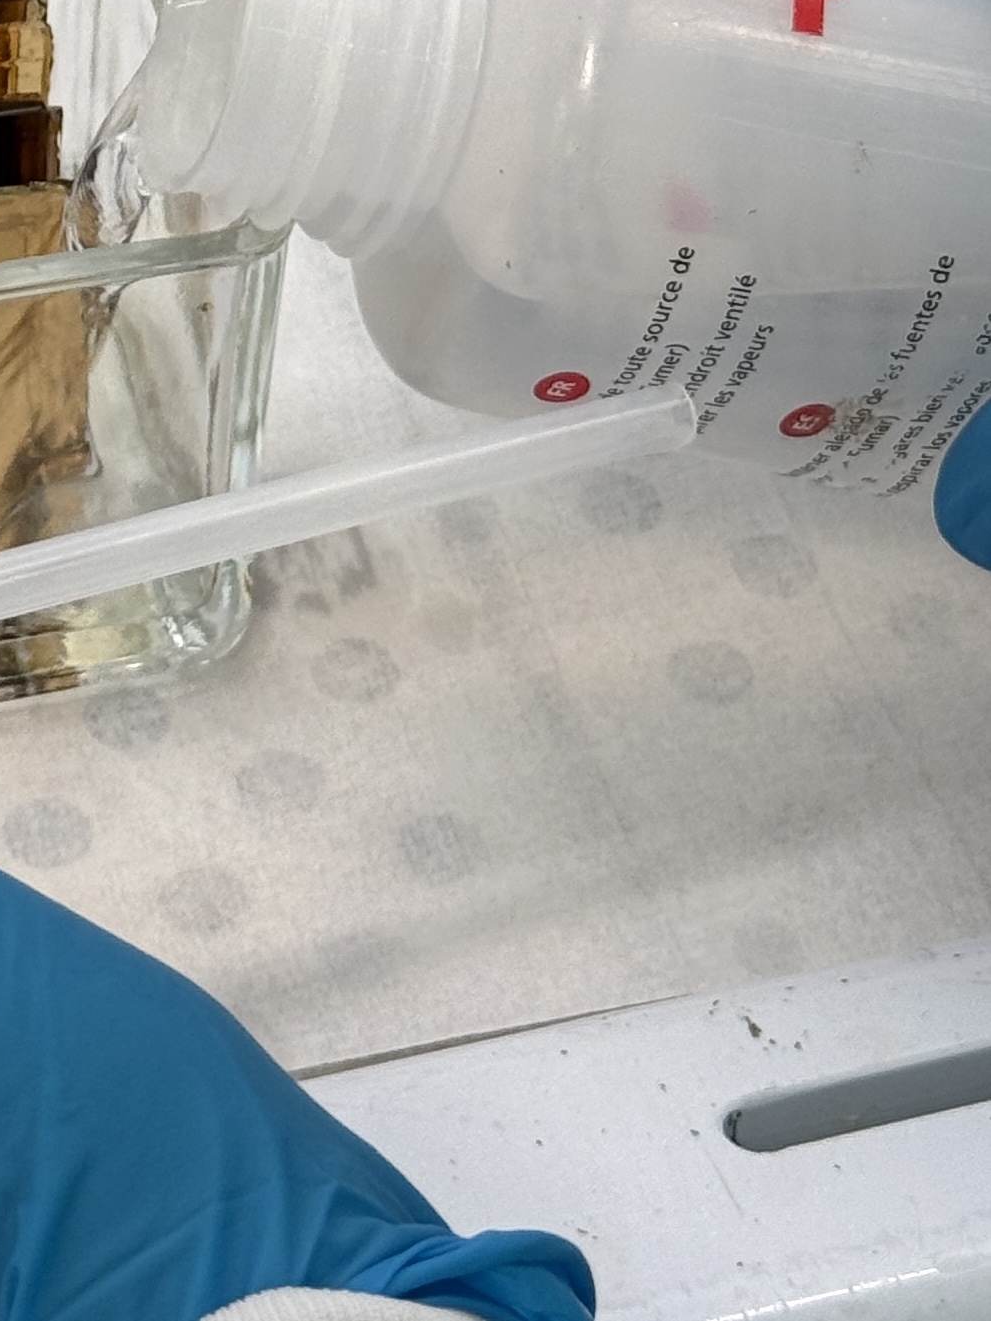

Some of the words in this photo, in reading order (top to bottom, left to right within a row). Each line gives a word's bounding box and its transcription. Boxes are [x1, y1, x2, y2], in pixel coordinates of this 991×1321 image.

[614, 346, 652, 386] toute
[643, 280, 683, 344] source
[669, 247, 695, 274] de
[714, 274, 757, 341] ventilé
[890, 290, 942, 360] fuentes
[930, 255, 955, 284] de
[547, 381, 577, 397] FR
[641, 344, 690, 390] umer)
[705, 390, 735, 412] les
[728, 324, 774, 388] vapeurs
[910, 389, 948, 424] bien
[923, 428, 953, 452] los
